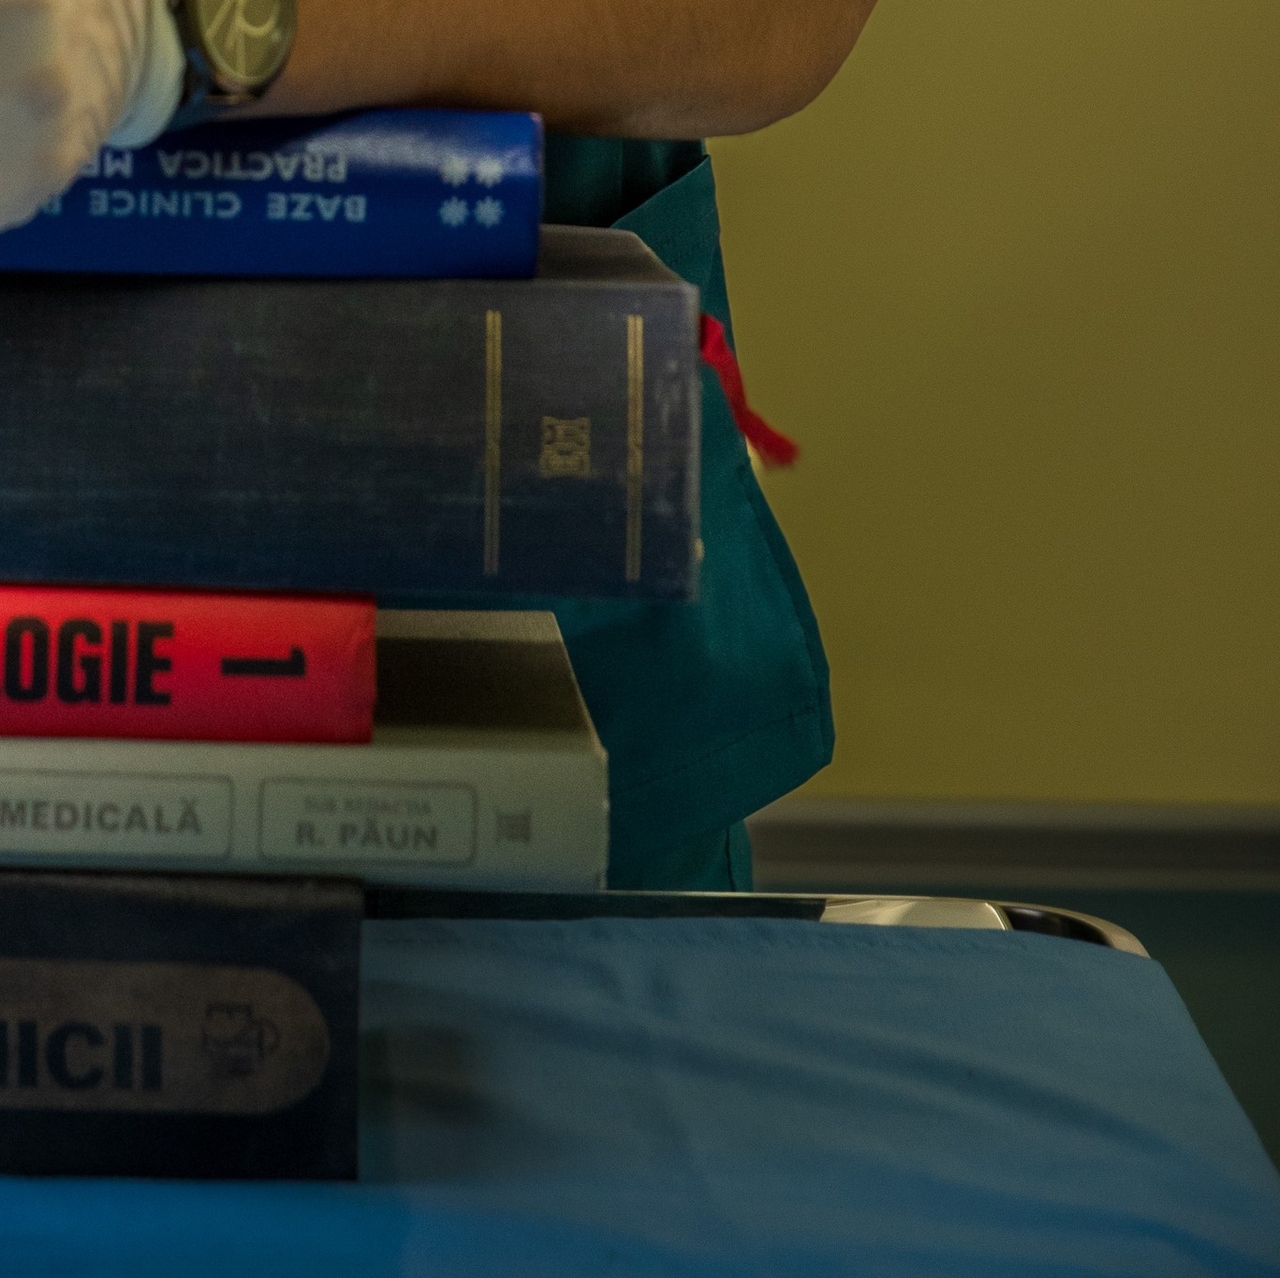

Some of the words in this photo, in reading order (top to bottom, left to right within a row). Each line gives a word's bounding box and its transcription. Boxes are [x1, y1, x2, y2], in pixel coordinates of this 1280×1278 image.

[157, 149, 347, 183] PRACTICA
[88, 189, 242, 219] CLINICE
[267, 192, 367, 223] BAZE
[295, 820, 325, 847] R.
[339, 816, 439, 851] PĂUN
